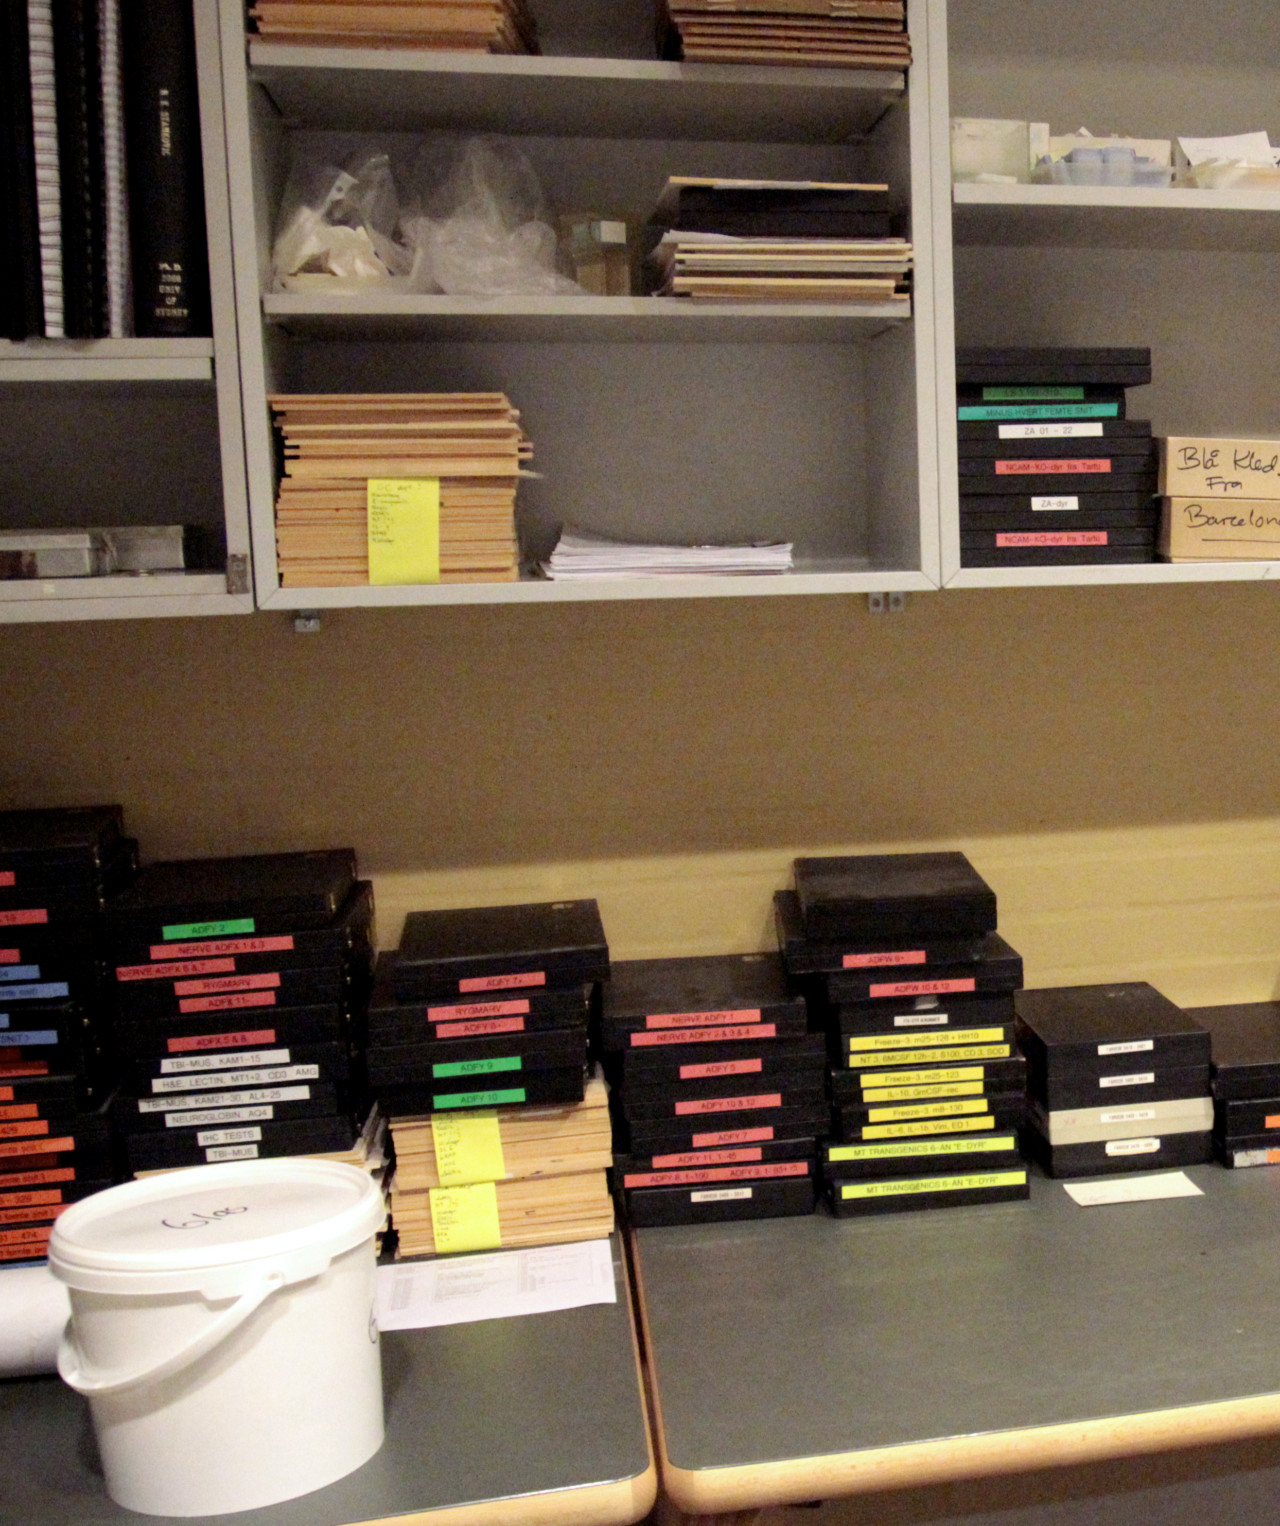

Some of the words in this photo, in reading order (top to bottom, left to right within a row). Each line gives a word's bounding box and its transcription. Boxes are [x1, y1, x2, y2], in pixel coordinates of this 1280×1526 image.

[1024, 427, 1035, 435] ZA
[1040, 427, 1049, 435] 01
[1063, 426, 1073, 434] 22
[1205, 476, 1243, 493] Fra
[1041, 499, 1069, 509] ZA-dyr
[178, 943, 210, 954] NERVE
[215, 941, 239, 951] ADFX
[250, 941, 258, 949] &
[118, 967, 152, 979] NERVE
[155, 964, 180, 976] ADFX
[191, 963, 199, 972] &
[455, 1004, 502, 1016] RYGMARV
[671, 1015, 701, 1025] NERVE
[704, 1014, 728, 1023] ADFY
[656, 1031, 686, 1042] NERVE
[689, 1030, 712, 1040] ADFY
[721, 1030, 727, 1038] &
[736, 1029, 743, 1037] &
[196, 1037, 221, 1047] ADFX
[231, 1036, 239, 1044] &
[219, 1054, 261, 1066] KAM1-15
[860, 1056, 872, 1064] NT
[295, 1067, 317, 1077] AMG
[460, 1062, 485, 1073] ADFY
[487, 1061, 494, 1070] 9
[705, 1065, 728, 1074] ADFY
[460, 1094, 486, 1104] ADFY
[488, 1093, 498, 1102] 10
[701, 1101, 724, 1110] ADFY
[203, 1133, 219, 1142] IHC
[224, 1130, 254, 1140] TESTS
[718, 1133, 740, 1142] ADFY
[212, 1147, 254, 1159] TBI-MUS
[853, 1149, 866, 1157] MT
[869, 1144, 928, 1156] TRANSGENICS
[940, 1143, 952, 1151] AN
[678, 1154, 701, 1164] ADFY
[650, 1174, 672, 1183] ADFY
[730, 1168, 752, 1178] ADFY
[866, 1186, 879, 1194] MT
[881, 1181, 940, 1193] TRANSGENICS
[952, 1179, 964, 1188] AN
